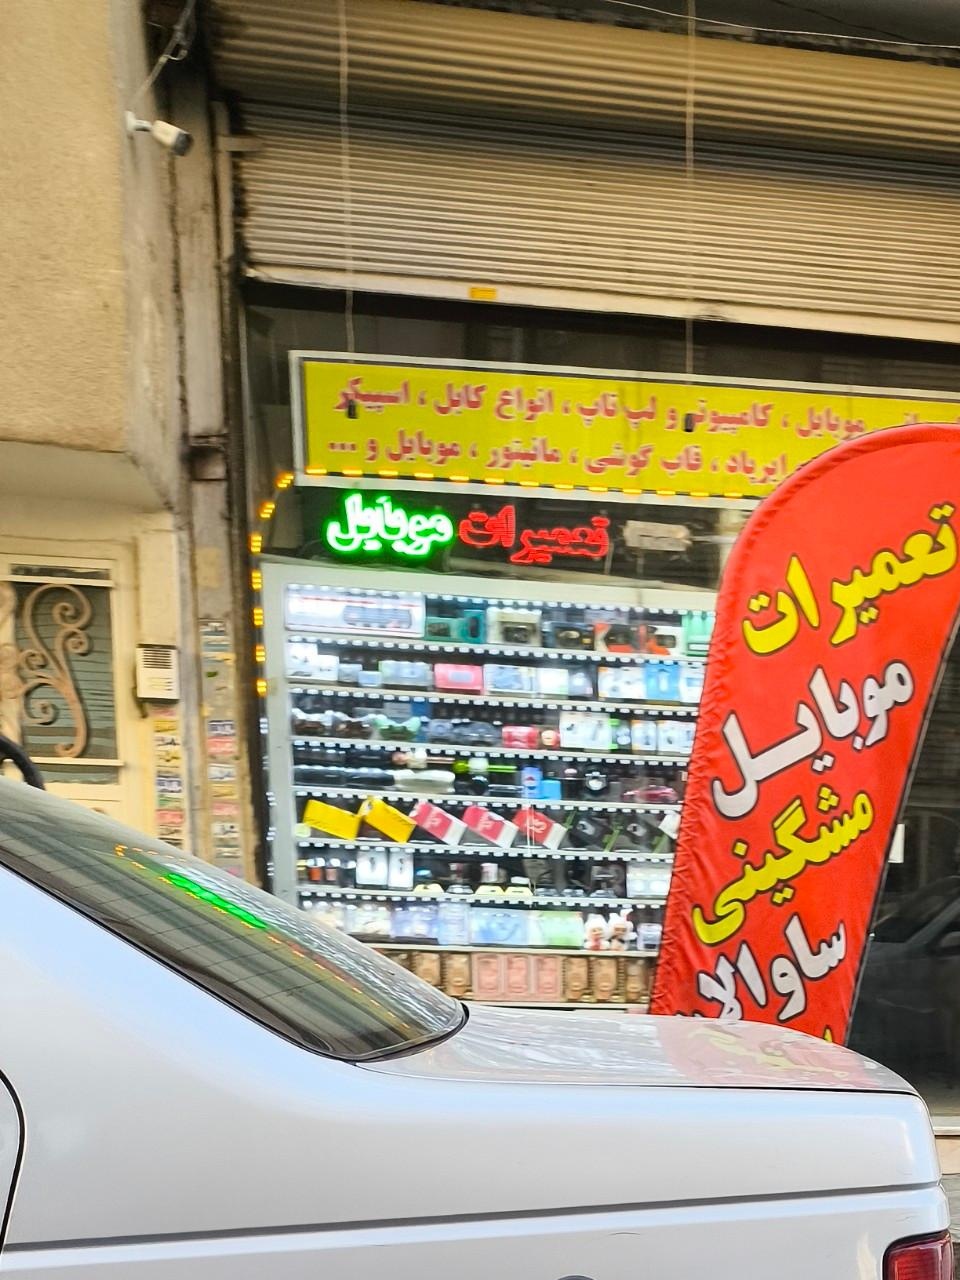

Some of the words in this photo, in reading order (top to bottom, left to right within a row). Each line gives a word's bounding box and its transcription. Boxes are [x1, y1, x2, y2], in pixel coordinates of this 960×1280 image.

[434, 382, 487, 416] کابل
[495, 387, 555, 422] انواع
[577, 392, 618, 427] تاپ
[624, 395, 657, 429] لپ
[796, 406, 865, 441] موبایل
[386, 428, 461, 466] موبایل
[485, 436, 561, 469] مانیتور
[584, 442, 654, 477] گوشی
[660, 444, 702, 478] قاب
[326, 493, 454, 556] موبایل
[458, 504, 612, 565] تعمیرات
[741, 503, 958, 655] تعمیرات
[711, 661, 914, 818] موبایل
[691, 785, 874, 946] مشگینی
[677, 913, 847, 1022] ساوالا
